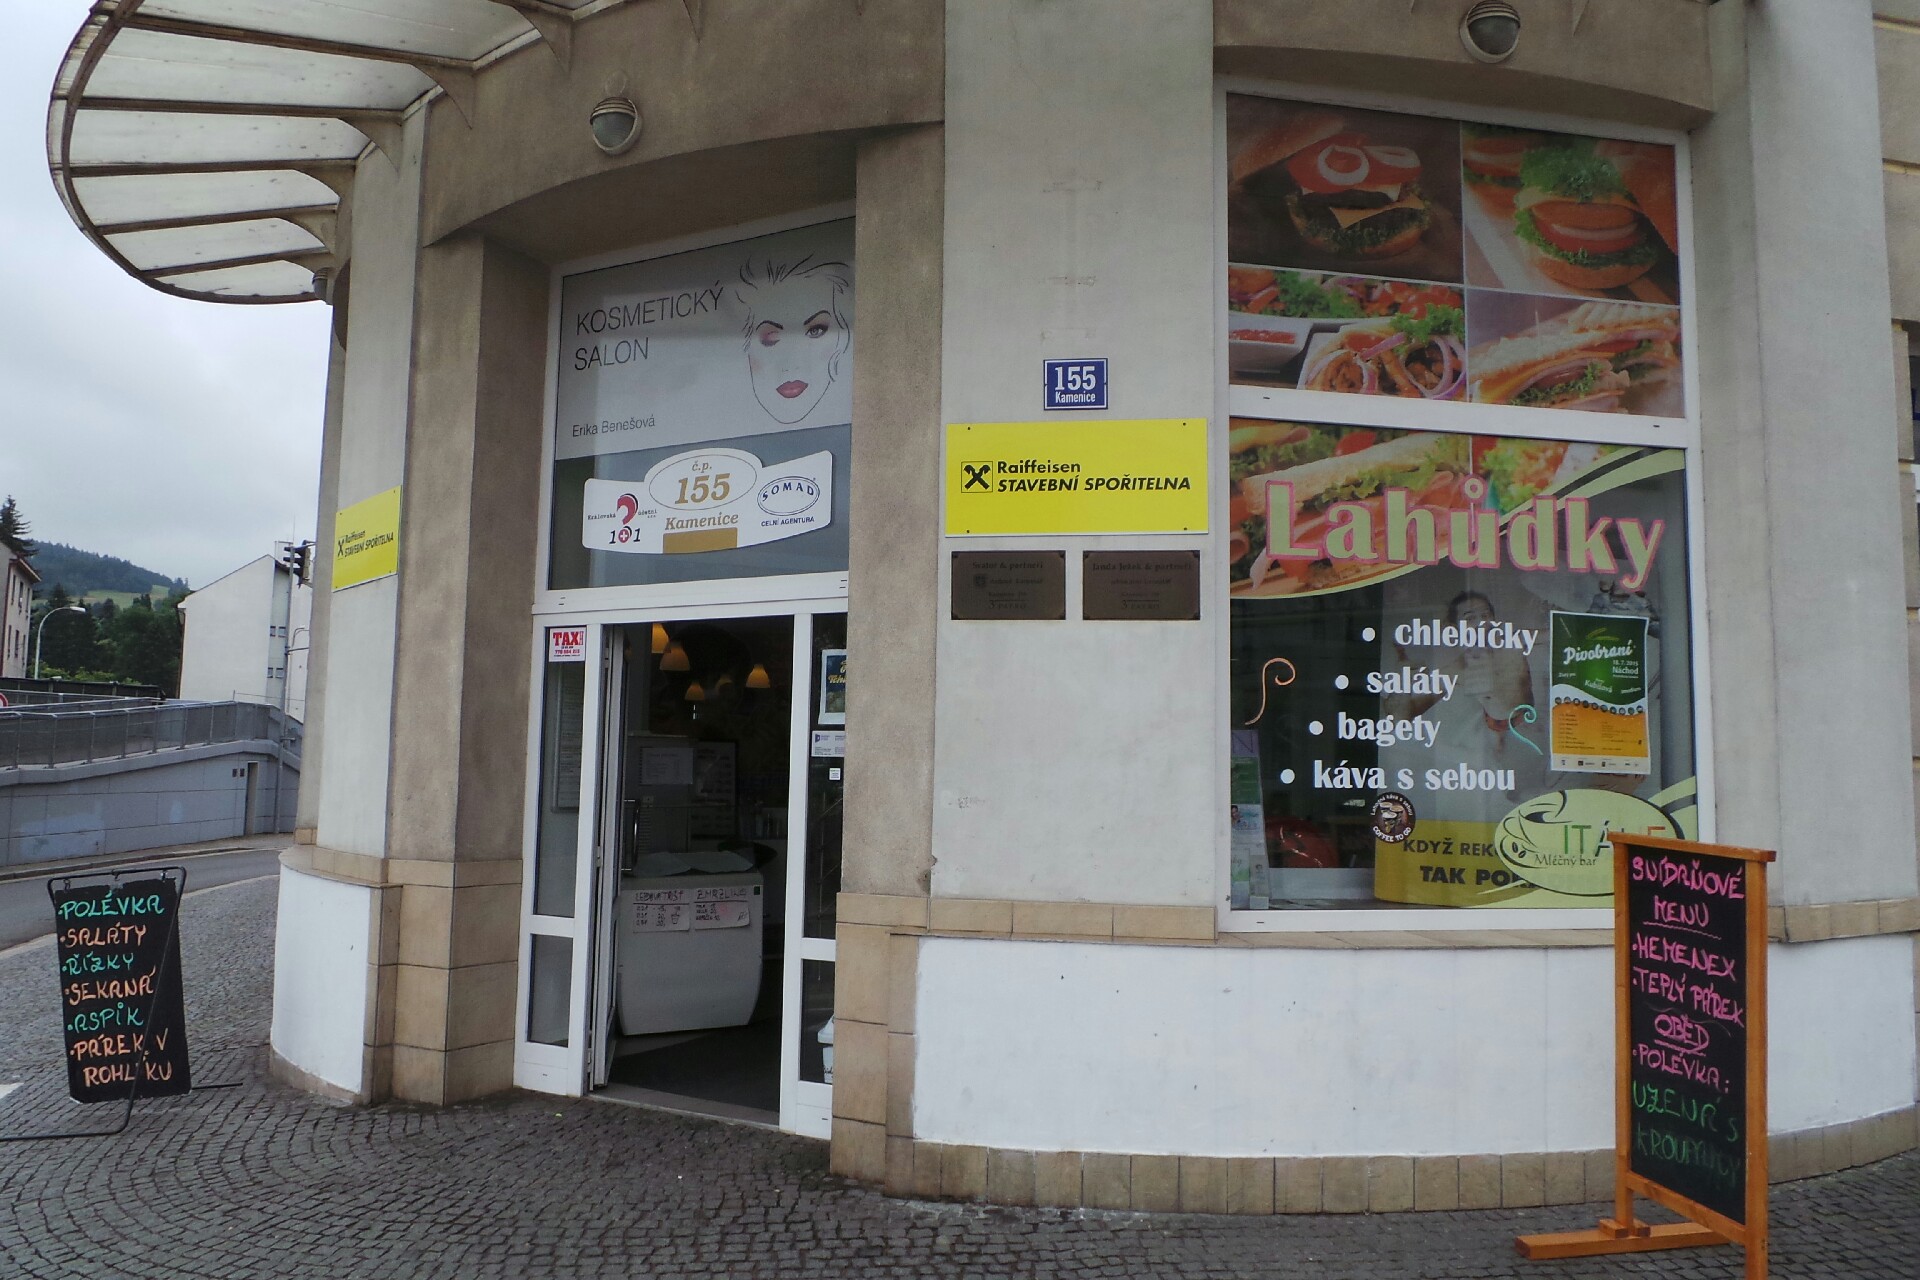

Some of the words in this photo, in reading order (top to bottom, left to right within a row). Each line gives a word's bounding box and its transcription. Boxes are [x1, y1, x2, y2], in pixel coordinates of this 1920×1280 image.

[576, 279, 724, 336] KOSMETICKÝ
[574, 337, 649, 371] SALON
[1054, 366, 1096, 391] 155
[1055, 391, 1096, 403] Kamenice
[572, 422, 598, 438] Erika
[601, 414, 656, 434] Benešová
[997, 460, 1081, 473] Raiffeisen
[674, 473, 731, 505] 155
[761, 481, 815, 502] SOMAD
[997, 475, 1080, 492] STAVEBNÍ
[1084, 473, 1191, 491] SPOŘITELNA
[664, 511, 739, 531] Kamenice
[780, 516, 815, 526] AGENTURA
[1265, 474, 1666, 591] Lahůdky
[1394, 618, 1539, 655] chlebíčky
[1563, 639, 1633, 665] Pivobraní
[1366, 666, 1458, 701] saláty
[1612, 666, 1639, 674] Náchod
[1338, 711, 1441, 748] bagety
[1313, 760, 1387, 790] káva
[1397, 769, 1414, 790] s
[1425, 762, 1515, 790] sebou
[1373, 825, 1394, 842] COFFEE
[1395, 833, 1404, 841] TO
[1403, 827, 1412, 836] GO
[1403, 838, 1454, 855] KDYŽ
[1460, 843, 1498, 857] REK
[1533, 853, 1577, 868] Mléčný
[1579, 856, 1597, 866] bar
[1420, 865, 1466, 885] TAK
[61, 890, 165, 921] POLÉVKA
[1654, 895, 1709, 927] MENU
[64, 921, 147, 948] SALÁTY
[65, 952, 134, 976] ŘÍZKY
[1636, 932, 1737, 983] HEMENEX
[70, 965, 156, 1005] SEKANÁ
[1633, 966, 1686, 1004] TEPLÝ
[73, 1033, 144, 1062] PÁREK
[156, 1027, 169, 1051] V
[1654, 1013, 1710, 1051] OBĚD
